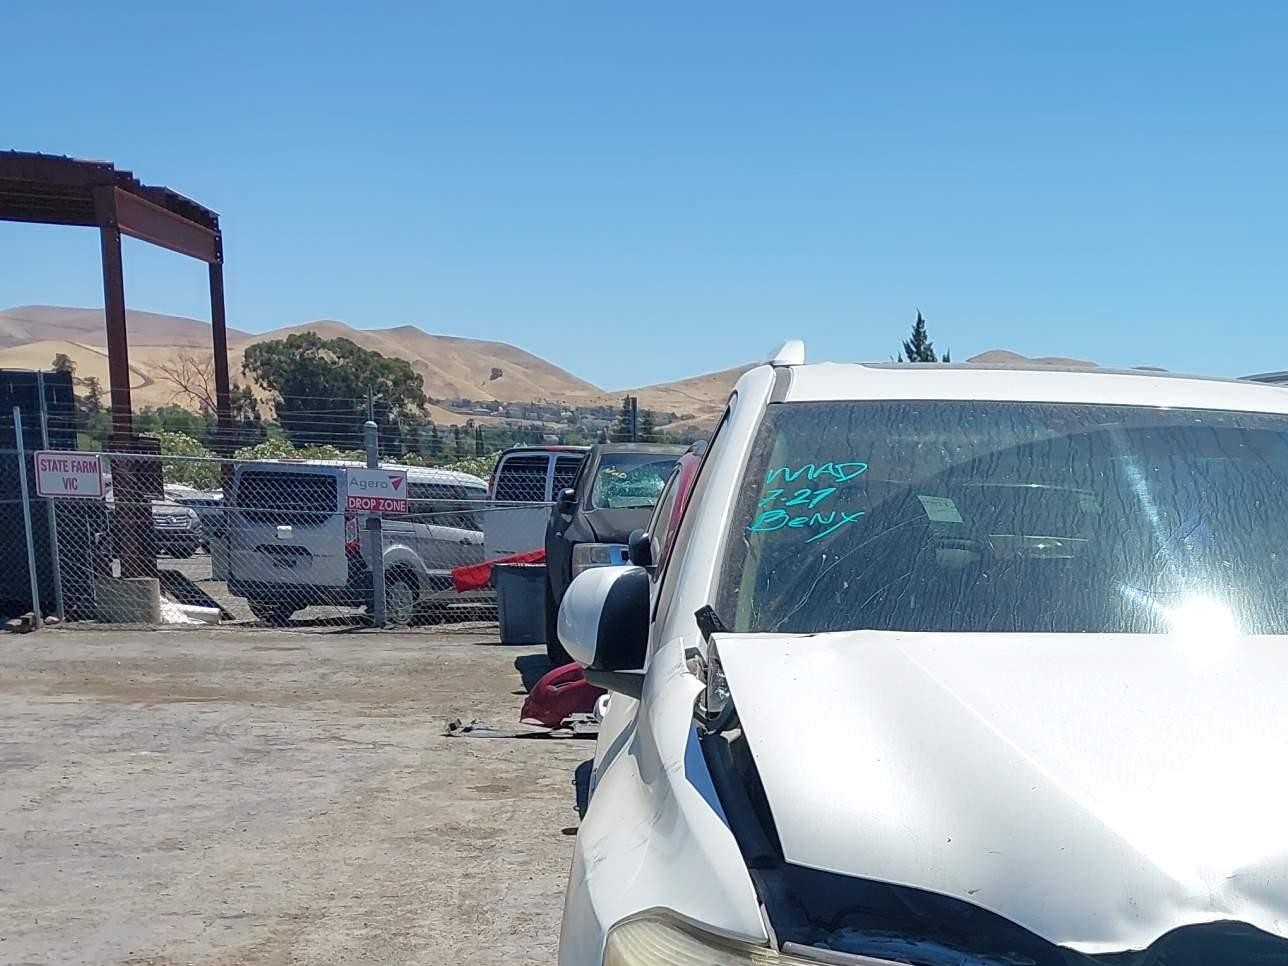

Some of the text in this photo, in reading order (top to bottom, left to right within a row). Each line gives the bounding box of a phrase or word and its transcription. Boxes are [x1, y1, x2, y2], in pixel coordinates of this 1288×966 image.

[40, 459, 98, 473] STATE FARM
[767, 462, 868, 484] MAD
[62, 477, 78, 490] VIC
[349, 477, 388, 490] Agero
[349, 498, 406, 512] DROP ZONE
